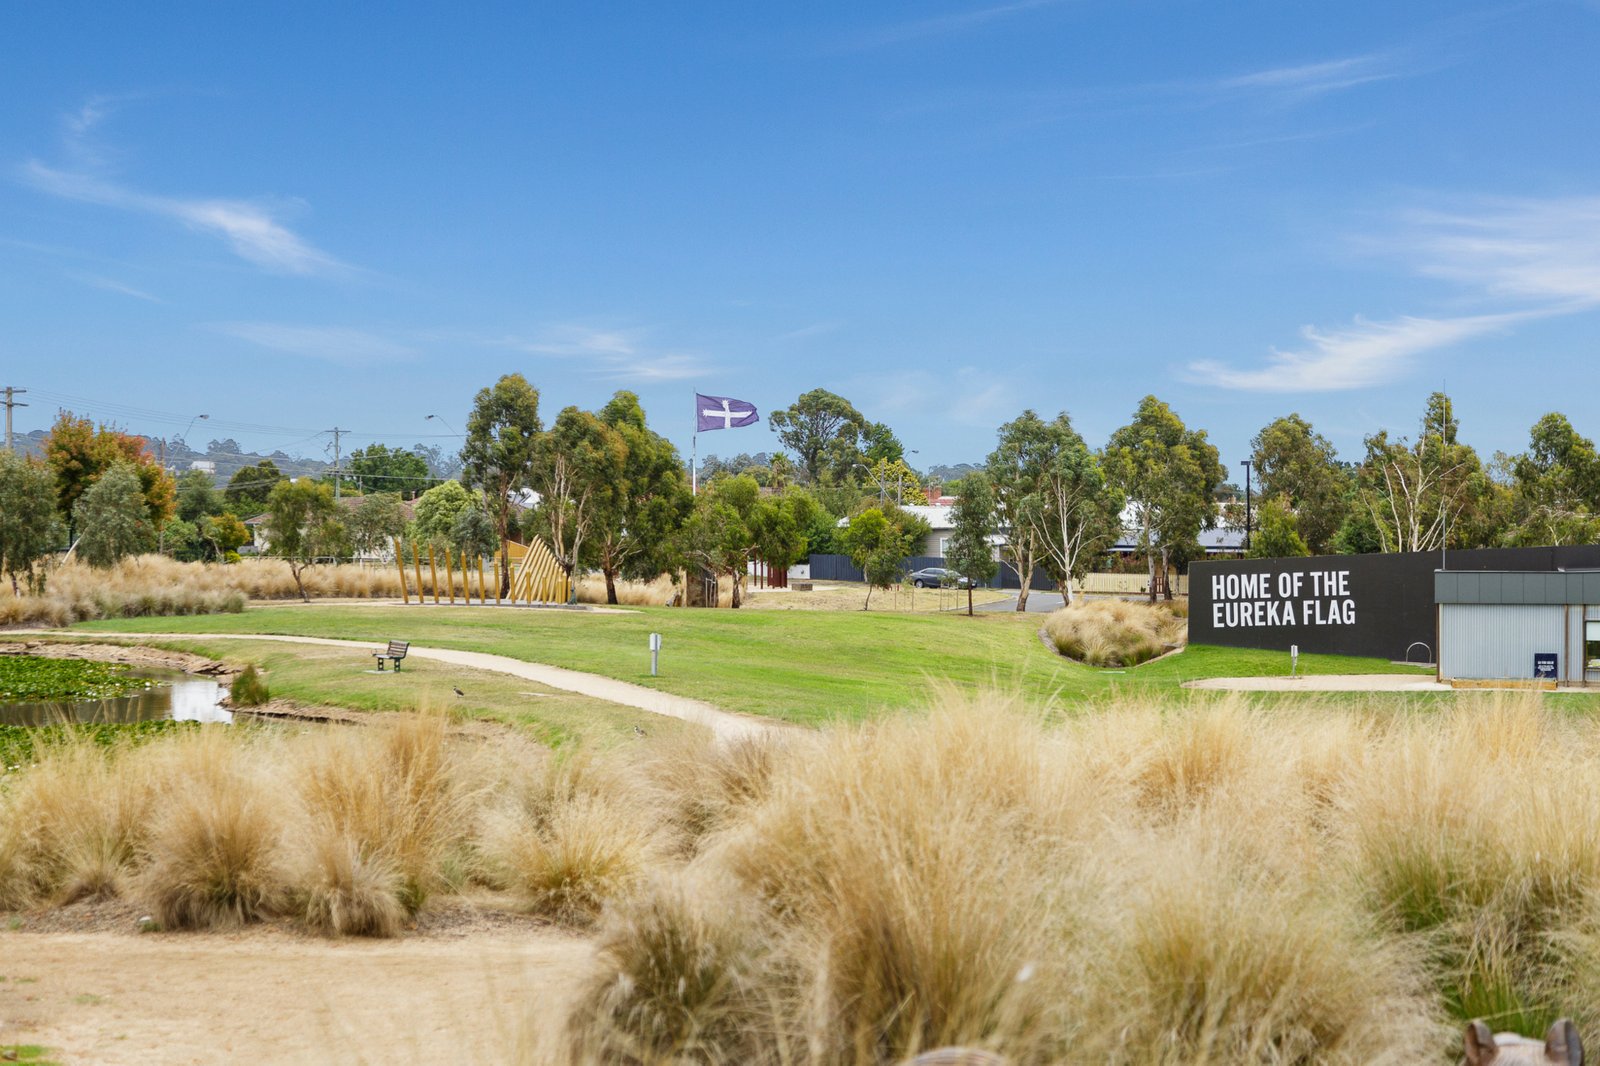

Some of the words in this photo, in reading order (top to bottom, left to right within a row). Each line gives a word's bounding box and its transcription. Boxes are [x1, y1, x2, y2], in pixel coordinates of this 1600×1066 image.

[1211, 574, 1272, 600] HOME
[1279, 572, 1304, 598] OF
[1309, 571, 1351, 597] THE
[1212, 601, 1296, 628] EUREKA
[1303, 599, 1356, 625] FLAG
